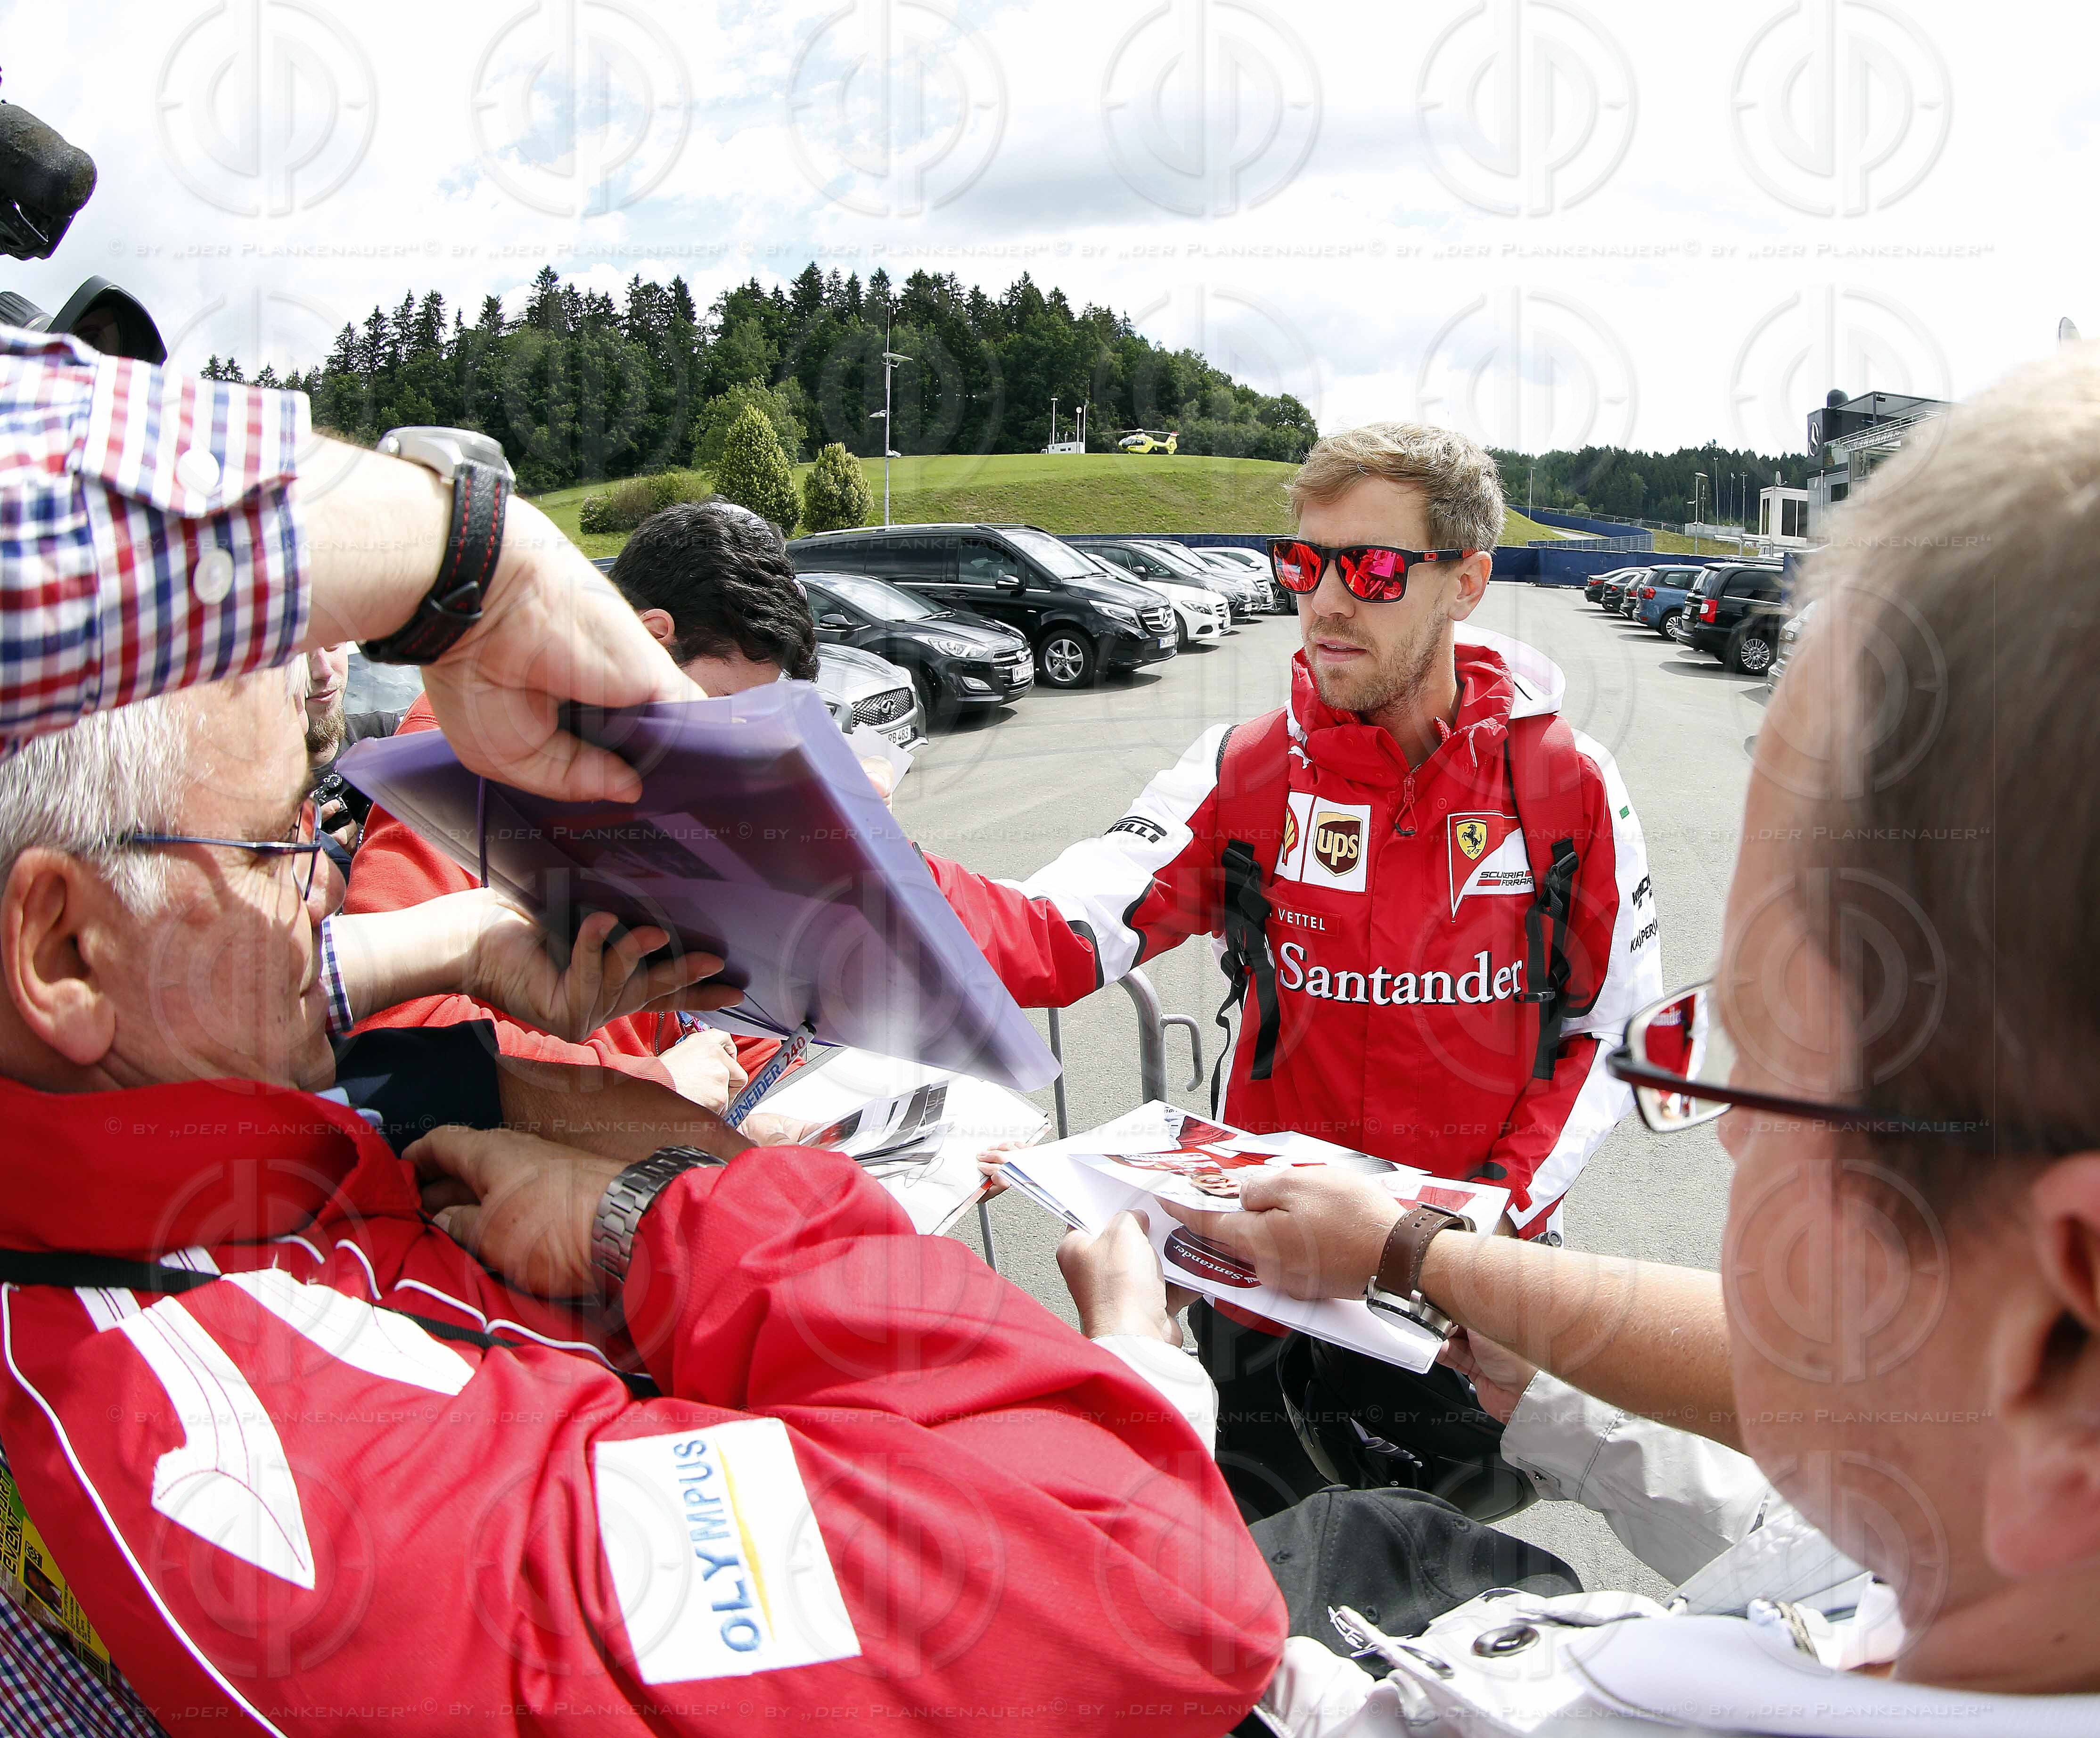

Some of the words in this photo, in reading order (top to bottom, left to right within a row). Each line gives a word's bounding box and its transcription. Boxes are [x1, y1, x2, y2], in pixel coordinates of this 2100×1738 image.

[898, 728, 909, 741] 483
[1316, 827, 1359, 866] ups
[1501, 877, 1534, 886] FERRAR
[1278, 907, 1326, 931] VETTEL
[1279, 942, 1524, 1006] Santander
[782, 1036, 805, 1066] 240
[1173, 1244, 1243, 1279] Santander
[673, 1438, 763, 1653] OLYMPUS
